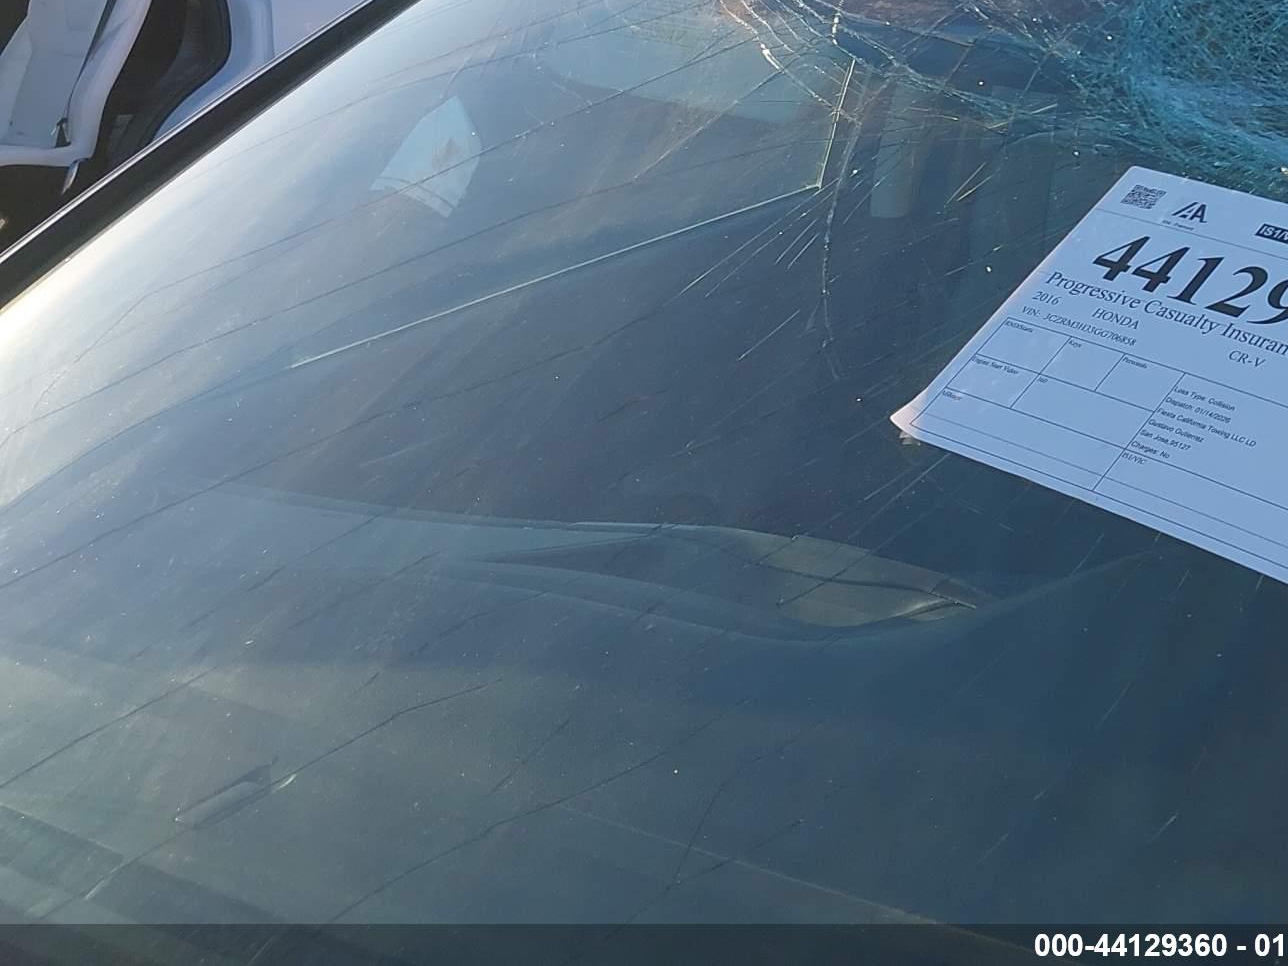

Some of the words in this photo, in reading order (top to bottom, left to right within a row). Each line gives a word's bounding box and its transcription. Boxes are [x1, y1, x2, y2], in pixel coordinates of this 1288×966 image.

[1022, 306, 1041, 317] VIN:
[1045, 271, 1141, 309] Progressive
[1144, 299, 1220, 335] Casualty
[1032, 291, 1061, 306] 2016
[1092, 308, 1140, 330] HONDA
[1228, 350, 1267, 368] CR-V
[1068, 340, 1082, 349] Keys
[1174, 386, 1189, 397] Loss
[1208, 397, 1236, 412] Collision
[1194, 407, 1231, 424] 01/14/2026
[1139, 429, 1153, 439] San
[1148, 419, 1174, 432] Gustavo
[1157, 408, 1176, 419] Fiesta
[1176, 415, 1206, 430] California
[1207, 425, 1230, 439] Towing
[1231, 433, 1245, 443] LLC
[1245, 438, 1257, 448] LD
[1130, 441, 1158, 455] Charges:
[1159, 450, 1170, 459] No
